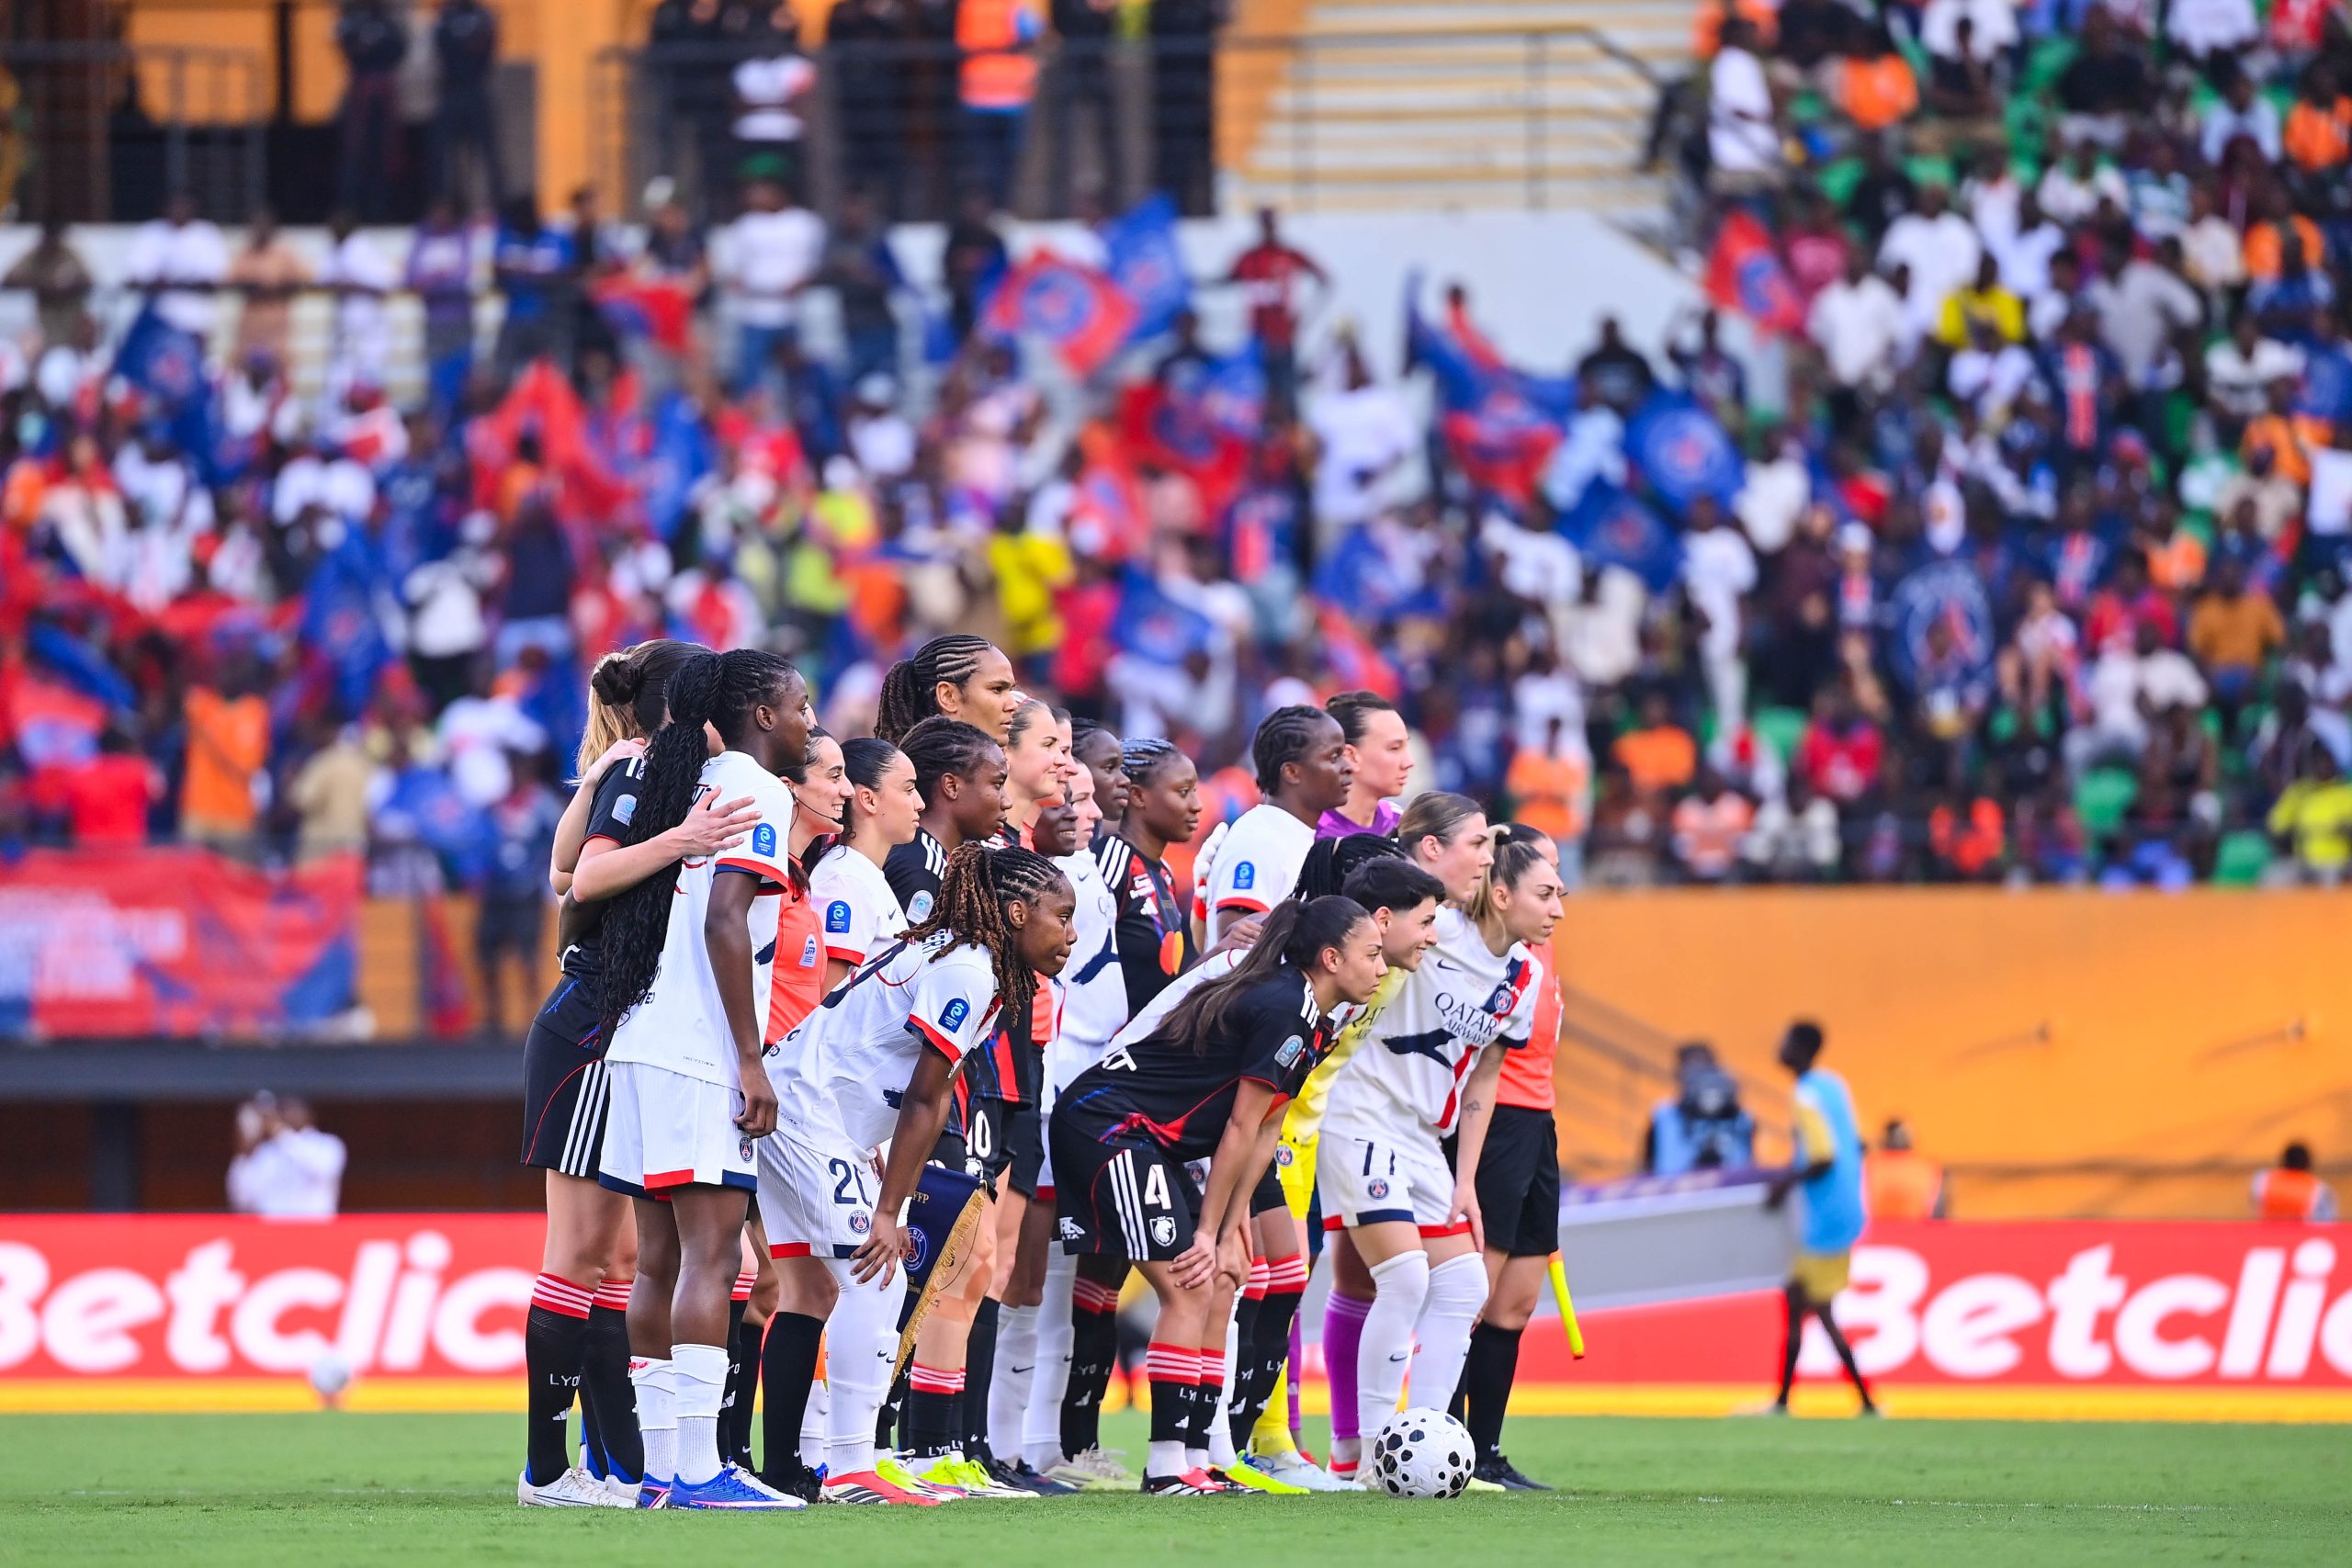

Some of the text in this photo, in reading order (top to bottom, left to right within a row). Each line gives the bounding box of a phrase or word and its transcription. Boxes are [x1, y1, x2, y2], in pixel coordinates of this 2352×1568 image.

[1435, 992, 1498, 1036] QATAR
[1443, 1020, 1487, 1045] AIRWAYS
[1144, 1164, 1172, 1210] 4
